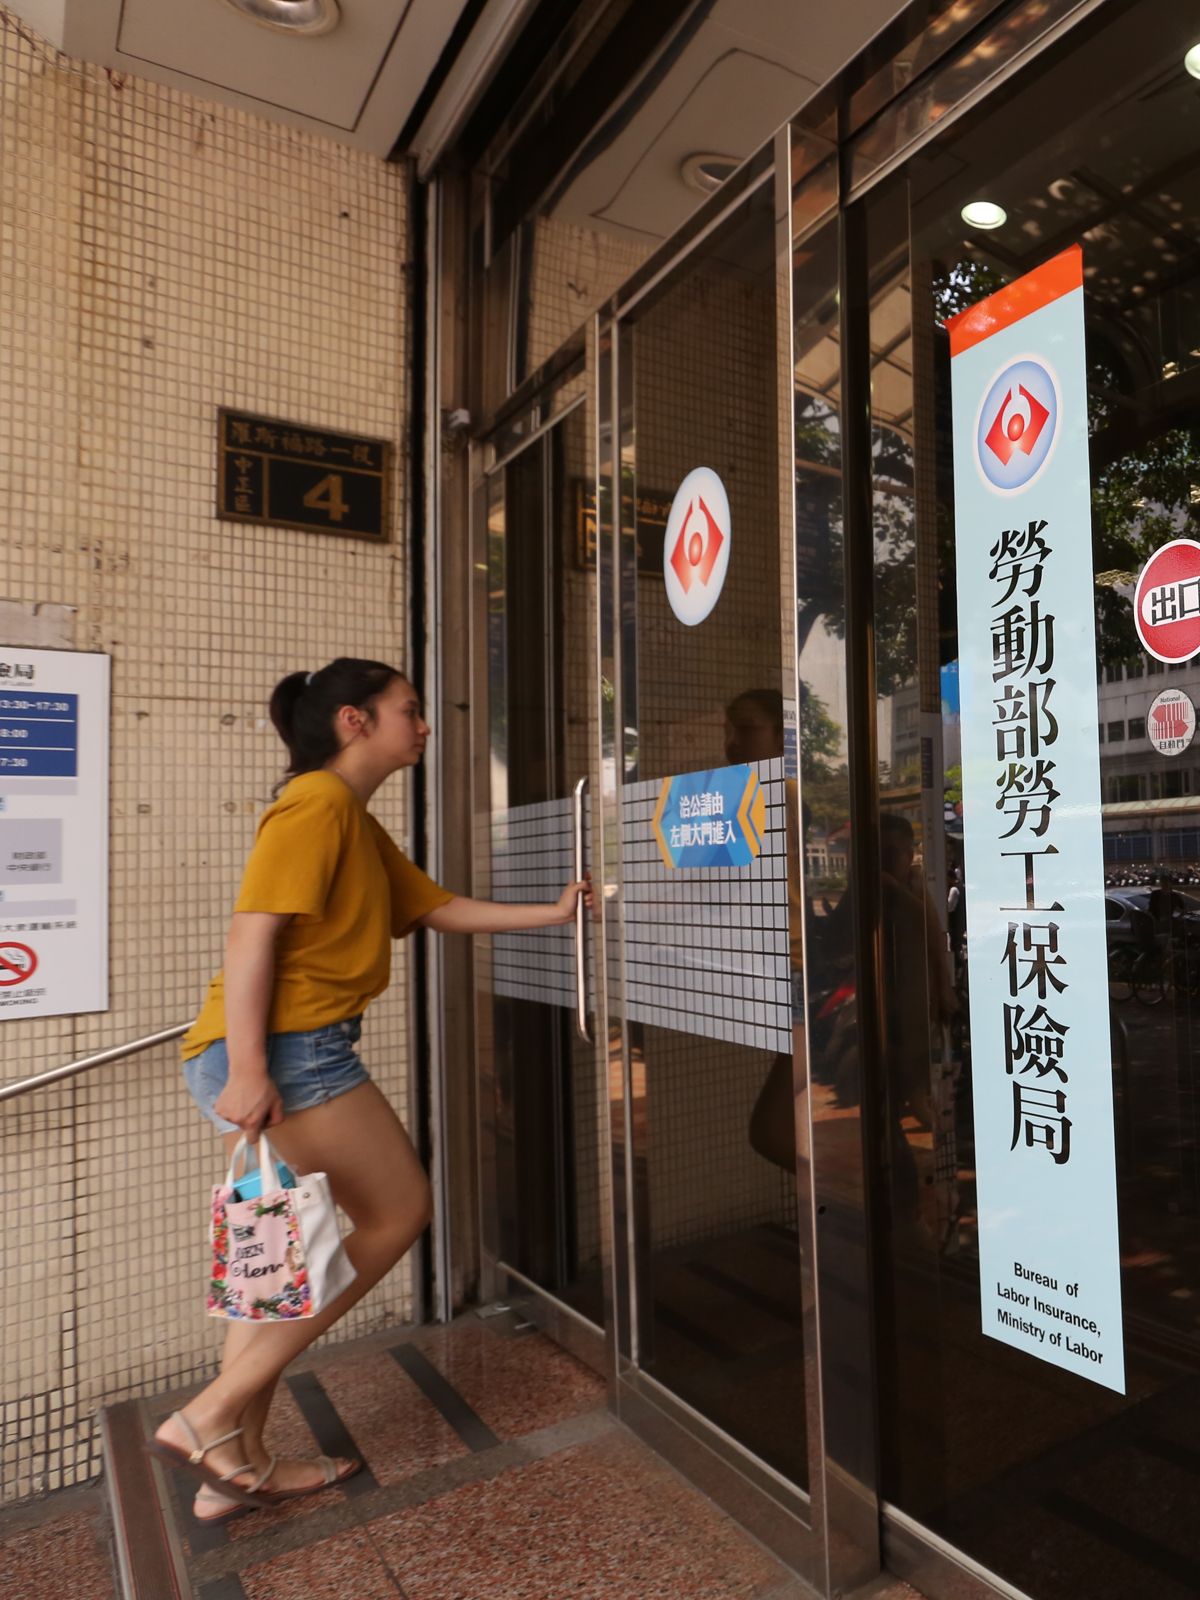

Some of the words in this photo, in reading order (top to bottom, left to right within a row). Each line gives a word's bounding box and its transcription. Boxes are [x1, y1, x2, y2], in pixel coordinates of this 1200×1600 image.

[303, 474, 350, 522] 4
[1160, 694, 1181, 703] National
[1159, 738, 1185, 750] 自動門
[679, 791, 724, 819] 洽公請由
[670, 820, 737, 848] 左側大門進入
[989, 520, 1072, 1164] 勞動部勞工保險局
[1014, 1262, 1058, 1290] Bureau
[1066, 1283, 1079, 1298] of
[997, 1282, 1030, 1307] Labor
[1034, 1296, 1101, 1337] Insurance,
[997, 1308, 1045, 1343] Ministry
[1049, 1332, 1062, 1347] of
[1066, 1336, 1104, 1364] Labor
